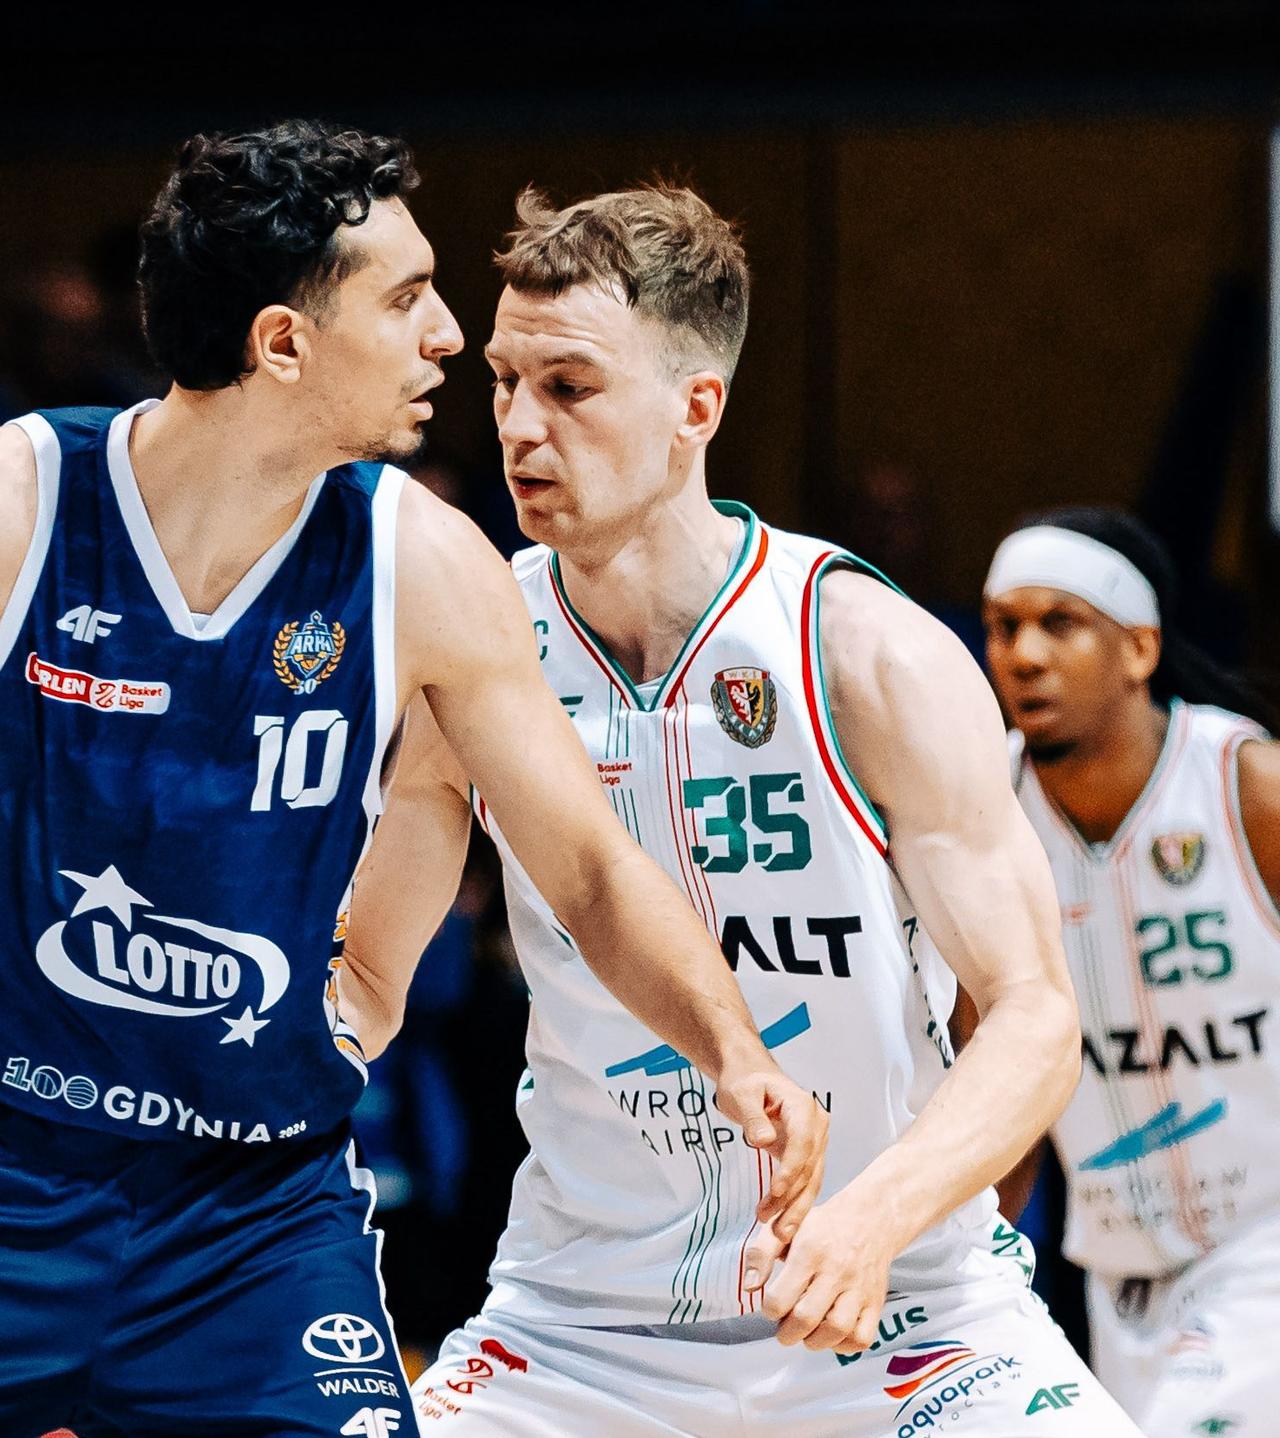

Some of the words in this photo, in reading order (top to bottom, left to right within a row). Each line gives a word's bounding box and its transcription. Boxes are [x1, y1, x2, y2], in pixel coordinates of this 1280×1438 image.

[56, 604, 123, 644] 4F
[120, 697, 145, 711] Liga
[121, 684, 163, 698] Basket
[250, 709, 350, 812] 10
[683, 772, 813, 874] 35
[92, 920, 241, 1000] LOTTO
[721, 915, 863, 978] ALT
[1135, 908, 1234, 987] 25
[1081, 1008, 1269, 1077] AZALT
[1, 1056, 99, 1110] 100
[103, 1085, 272, 1144] GDYNIA
[317, 1378, 400, 1399] WALDER
[339, 1407, 402, 1438] 4F
[897, 1355, 1022, 1438] aquapark
